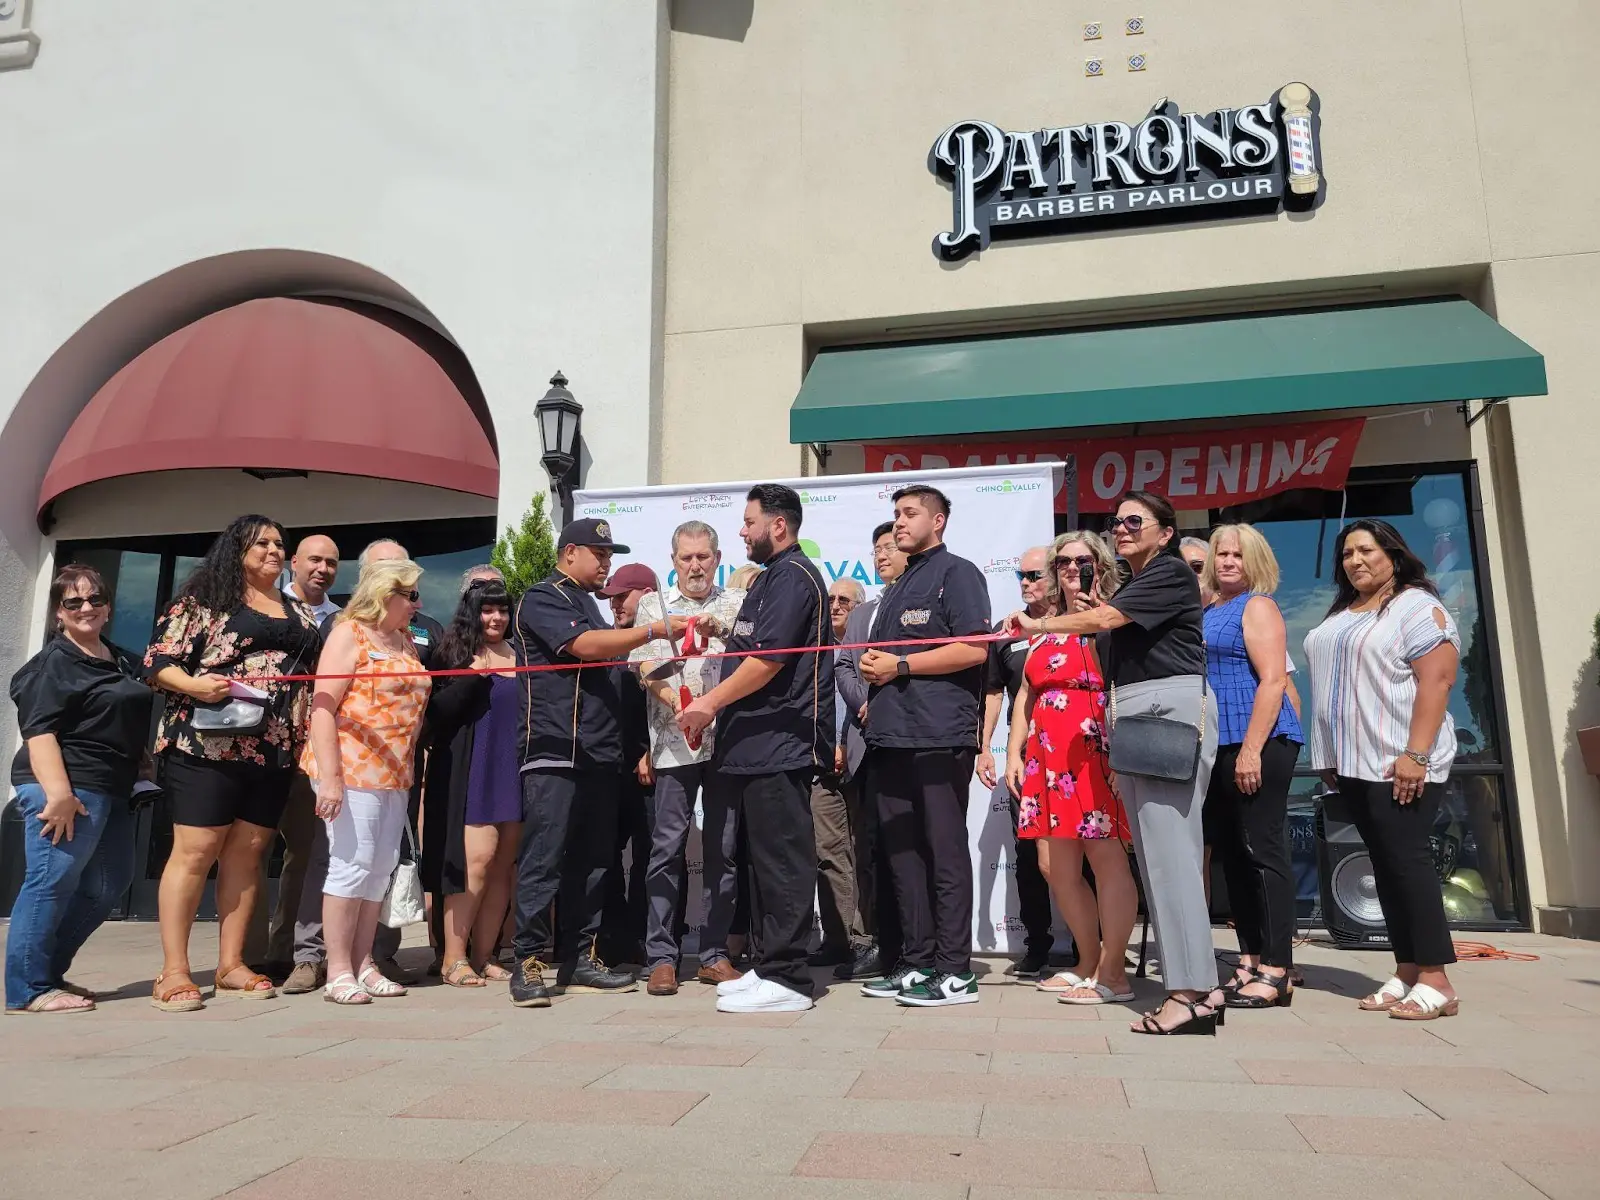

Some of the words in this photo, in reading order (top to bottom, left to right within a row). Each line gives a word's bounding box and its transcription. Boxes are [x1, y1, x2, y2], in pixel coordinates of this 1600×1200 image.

[996, 194, 1115, 222] BARBER
[1128, 178, 1273, 209] PARLOUR
[1092, 437, 1340, 500] OPENING
[975, 485, 1003, 493] CHINO
[1012, 482, 1042, 491] VALLEY
[809, 494, 837, 502] VALLEY
[583, 507, 609, 515] CHINO
[616, 505, 644, 513] VALLEY
